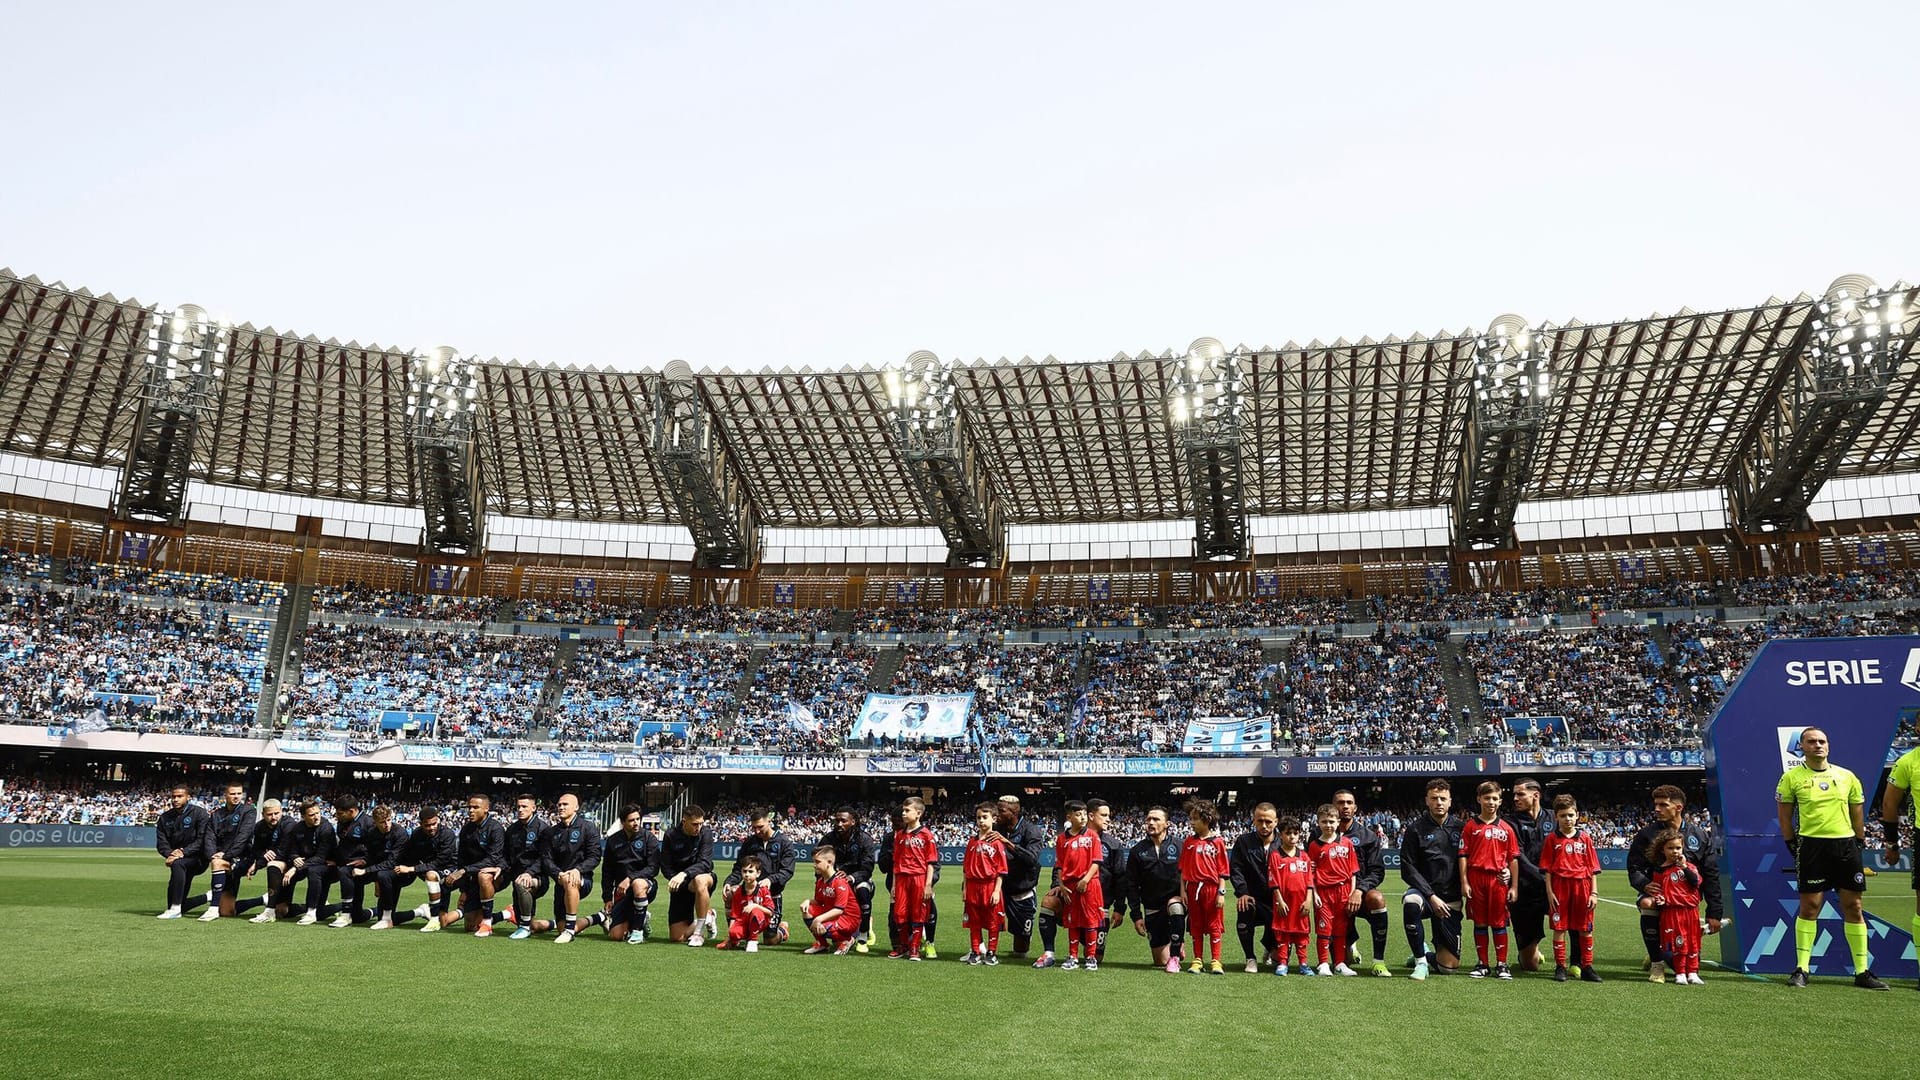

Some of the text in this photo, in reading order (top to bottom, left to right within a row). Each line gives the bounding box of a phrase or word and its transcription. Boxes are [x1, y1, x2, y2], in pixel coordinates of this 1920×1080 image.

[1785, 659, 1883, 686] SERIE
[408, 713, 414, 721] 9
[456, 746, 498, 758] UANM
[1505, 752, 1533, 764] BLUE
[614, 758, 659, 769] ACERRA
[725, 757, 759, 766] NAPOLI
[784, 757, 844, 770] CAIVANO
[996, 759, 1017, 772] CAVA
[1031, 760, 1059, 772] TIRRENI
[1063, 760, 1125, 773] CAMPOBASSO
[1308, 760, 1457, 772] STADIO DIEGO ARMANDO MARADONA
[9, 826, 105, 847] gas e luce
[1024, 919, 1032, 932] 9
